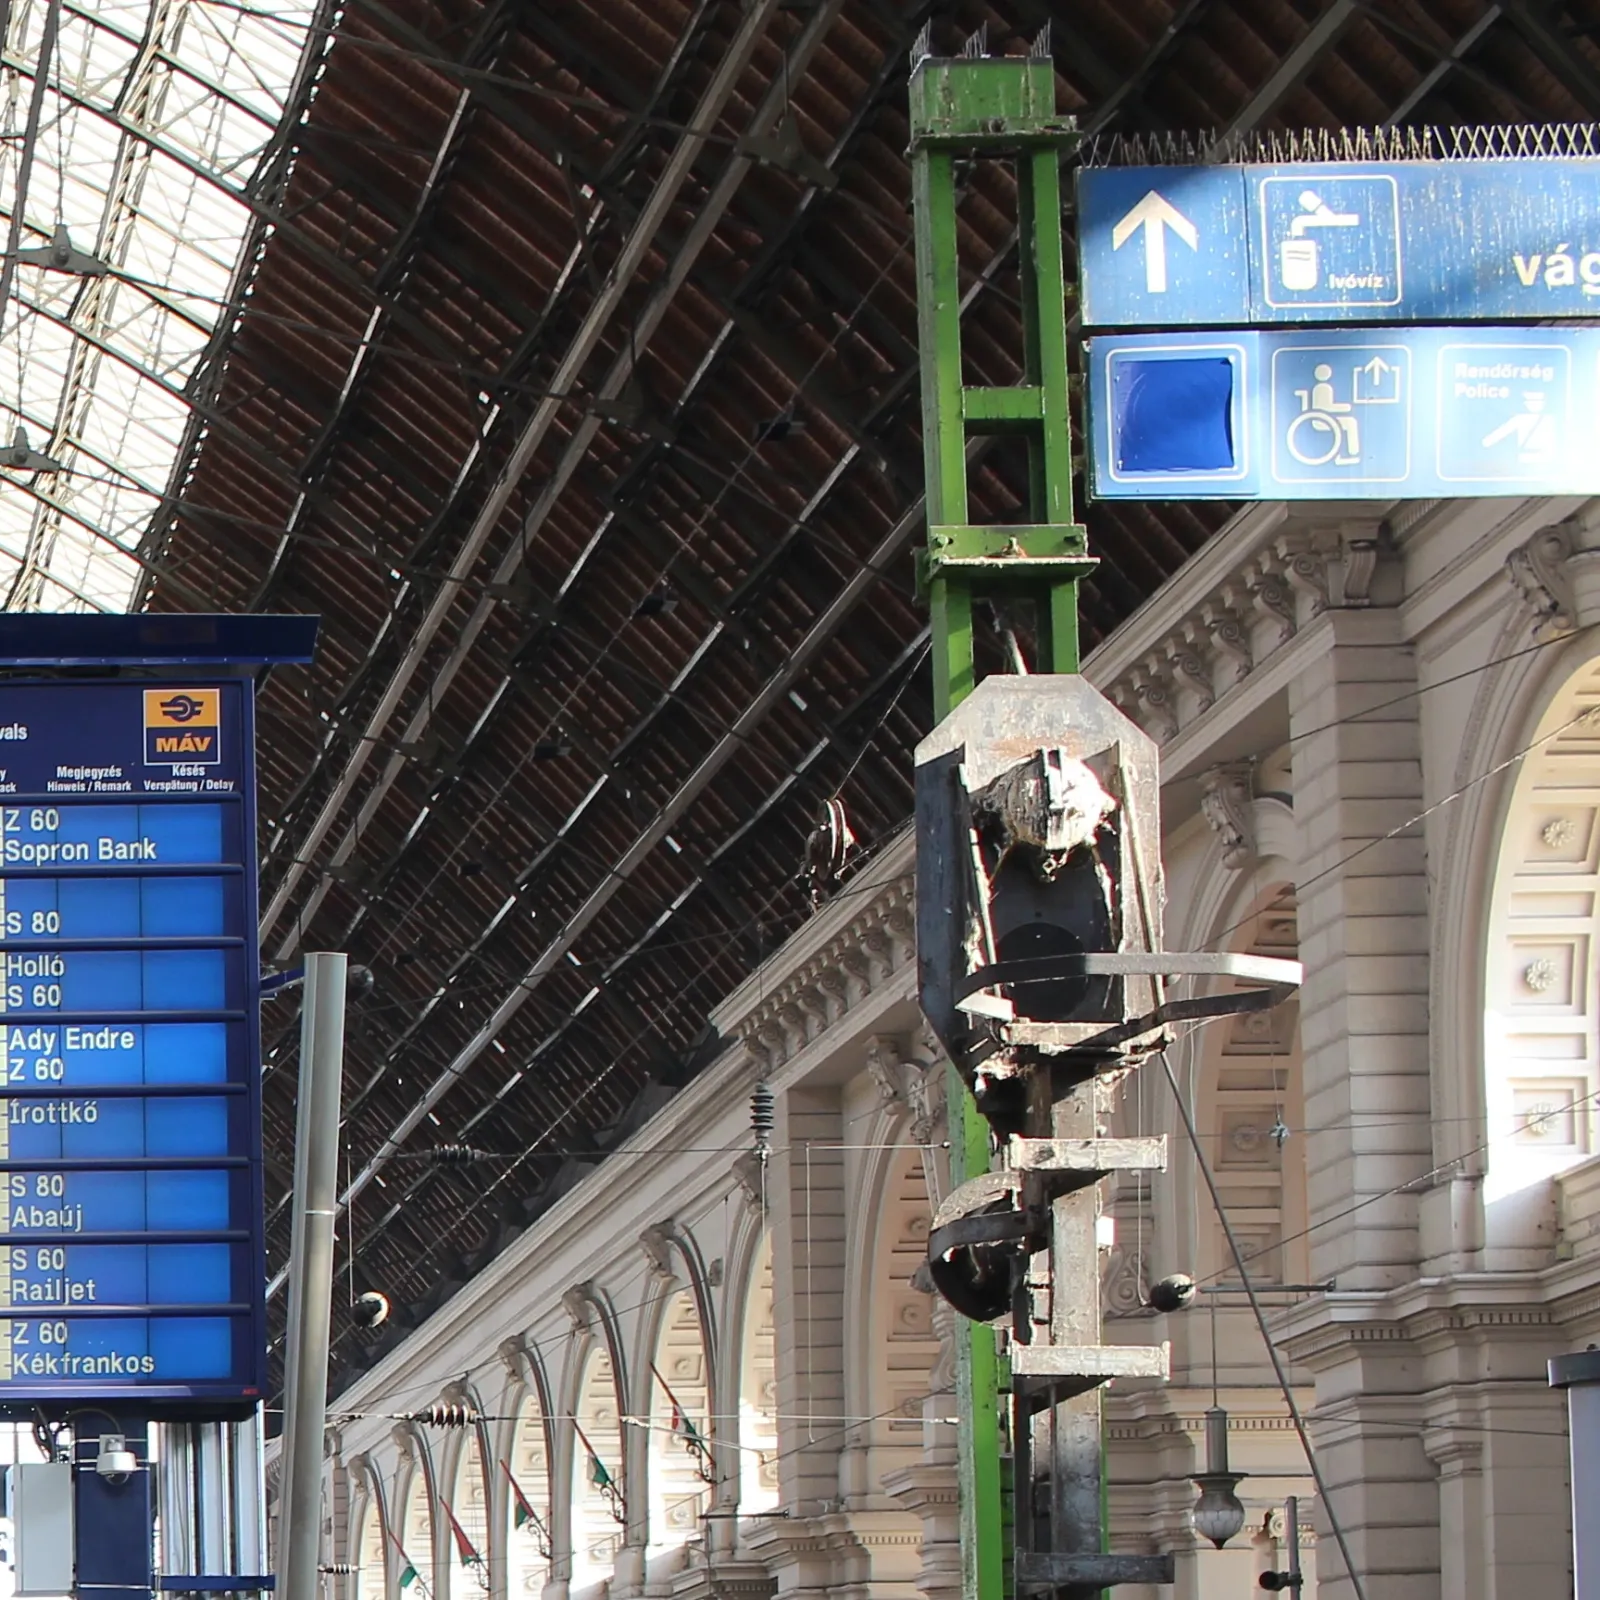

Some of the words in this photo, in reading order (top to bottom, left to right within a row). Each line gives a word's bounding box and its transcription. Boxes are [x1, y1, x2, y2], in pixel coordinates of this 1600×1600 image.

[1329, 273, 1384, 290] Ivóvíz
[1454, 383, 1509, 399] Police
[155, 732, 212, 753] MÁV
[56, 764, 122, 781] Megjegyzés
[172, 763, 206, 777] Késés
[47, 781, 87, 793] Hinweis
[94, 781, 132, 792] Remark
[143, 779, 198, 793] Verspätung
[205, 778, 235, 793] Delay
[5, 811, 20, 831] Z
[30, 809, 60, 831] 60
[4, 839, 89, 867] Sopron
[98, 837, 157, 861] Bank
[7, 913, 22, 934] S
[32, 912, 60, 933] 80
[12, 1205, 83, 1232] Abaúj
[12, 1279, 96, 1305] Railjet
[13, 1351, 155, 1376] Kékfrankos
